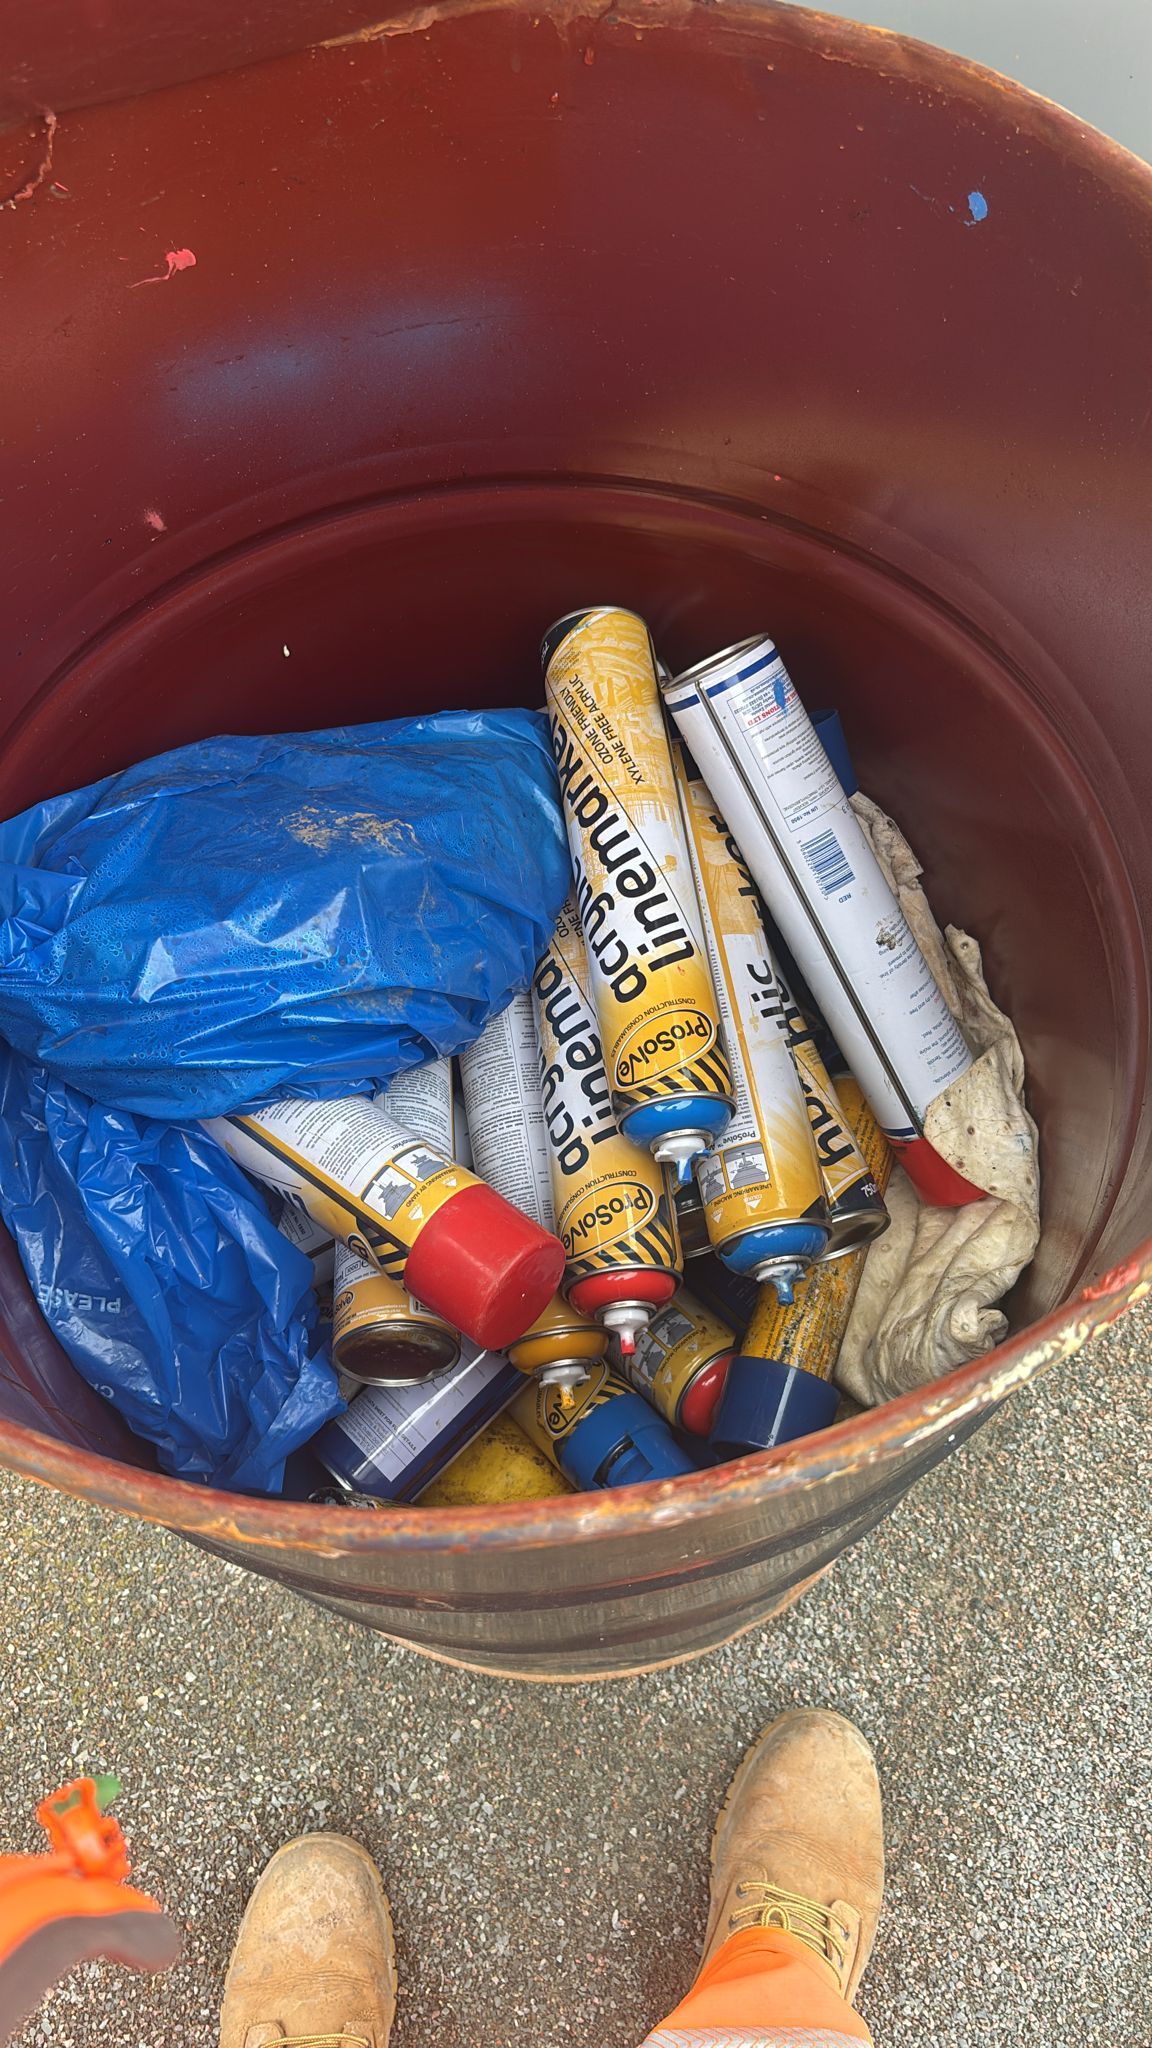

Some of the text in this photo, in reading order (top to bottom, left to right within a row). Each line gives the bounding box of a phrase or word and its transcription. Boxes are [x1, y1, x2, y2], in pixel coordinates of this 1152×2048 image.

[559, 686, 590, 730] FRIENDLY
[568, 674, 645, 785] XYLENE FREE ACRYLIC
[585, 731, 614, 765] OZONE
[838, 893, 851, 903] RED
[554, 915, 569, 938] OZO
[609, 997, 695, 1056] CONSTRUCTION CONSUMABLES
[535, 951, 620, 1144] linema
[617, 1016, 707, 1082] ProSolve
[536, 1033, 590, 1175] acry
[418, 1184, 426, 1192] BY
[584, 1169, 636, 1189] CONSTRUCTION
[732, 1182, 772, 1196] LINEMARKING
[860, 1182, 878, 1197] 750
[405, 1191, 419, 1207] HAND
[560, 1189, 647, 1255] ProSolve
